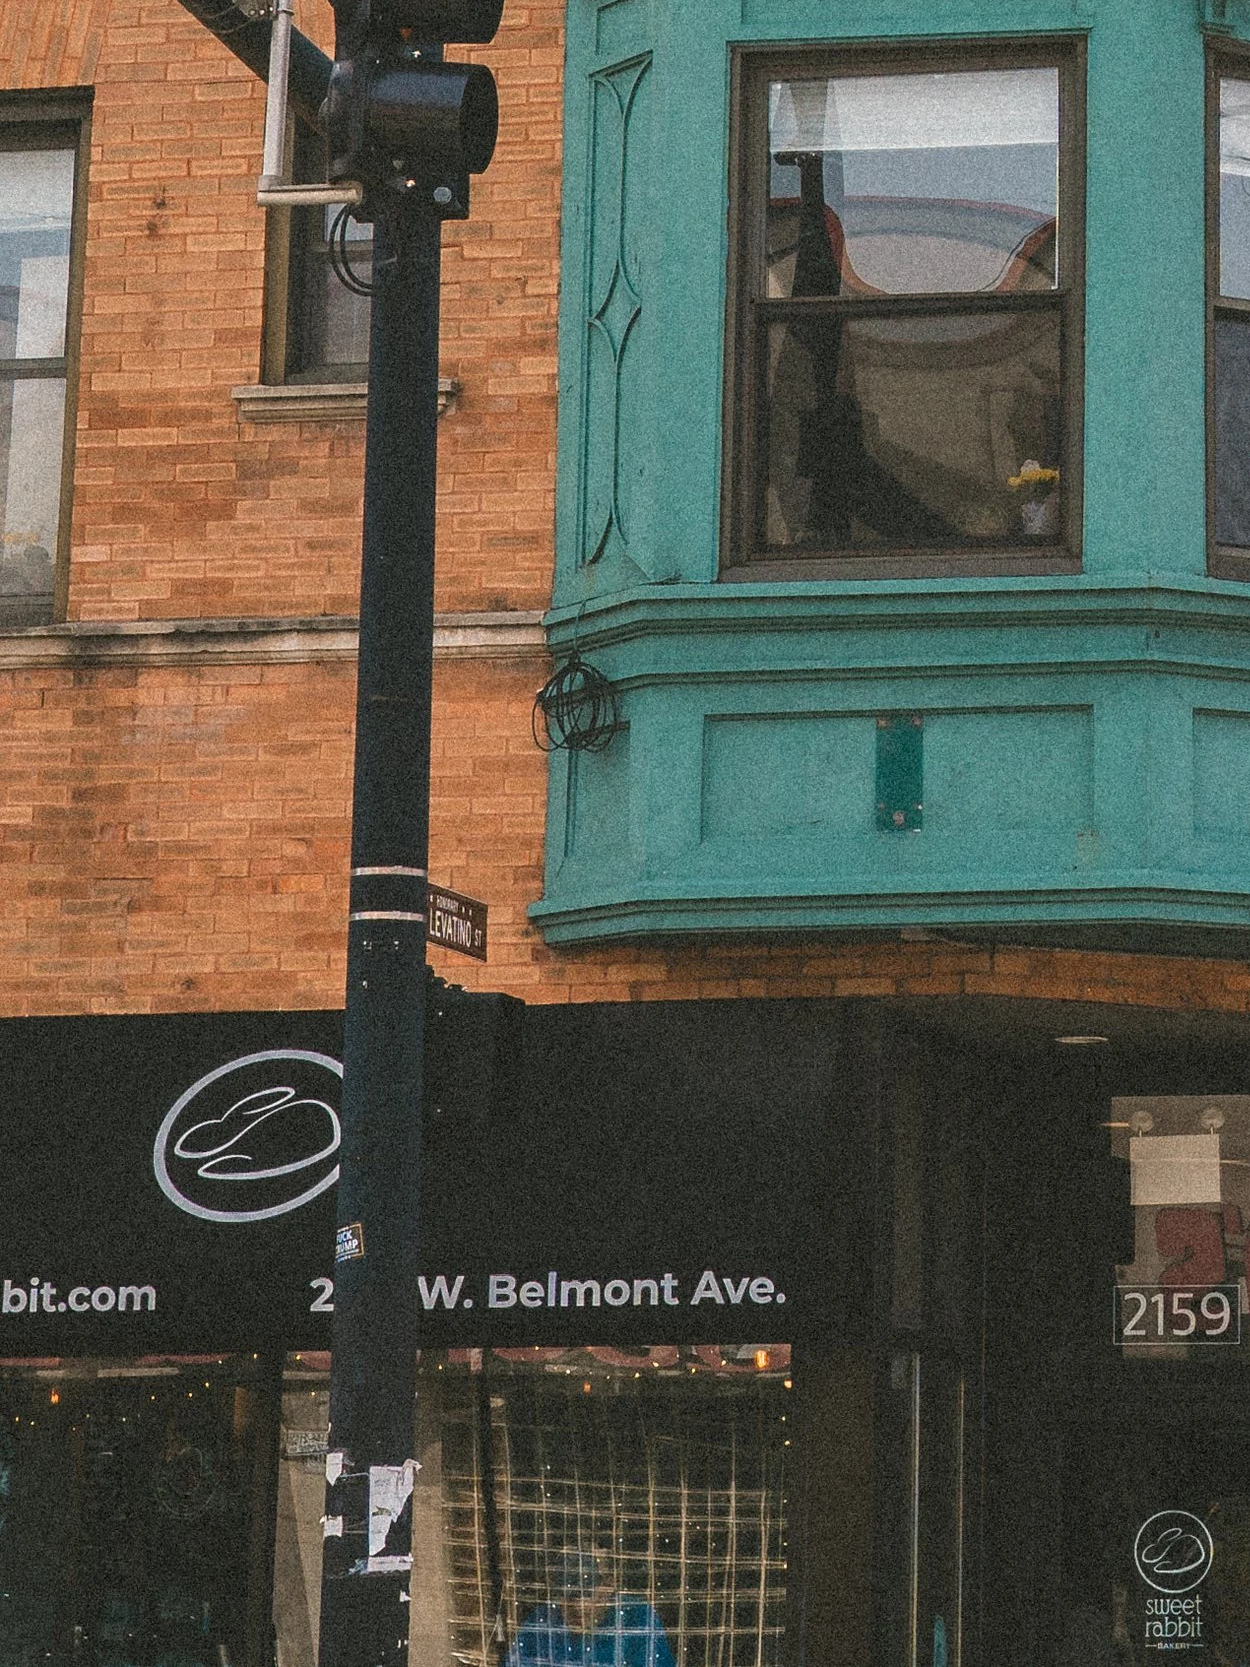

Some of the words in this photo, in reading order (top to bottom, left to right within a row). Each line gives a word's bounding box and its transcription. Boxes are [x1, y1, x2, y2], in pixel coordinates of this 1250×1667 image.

[429, 907, 472, 948] LEVATINO
[474, 928, 482, 947] ST
[2, 1277, 156, 1313] bit.com
[417, 1275, 473, 1310] W.
[488, 1271, 680, 1308] Belmont
[690, 1270, 786, 1305] Ave.
[1122, 1292, 1231, 1336] 2159
[1145, 1594, 1202, 1615] sweet
[1145, 1616, 1203, 1637] rabbit
